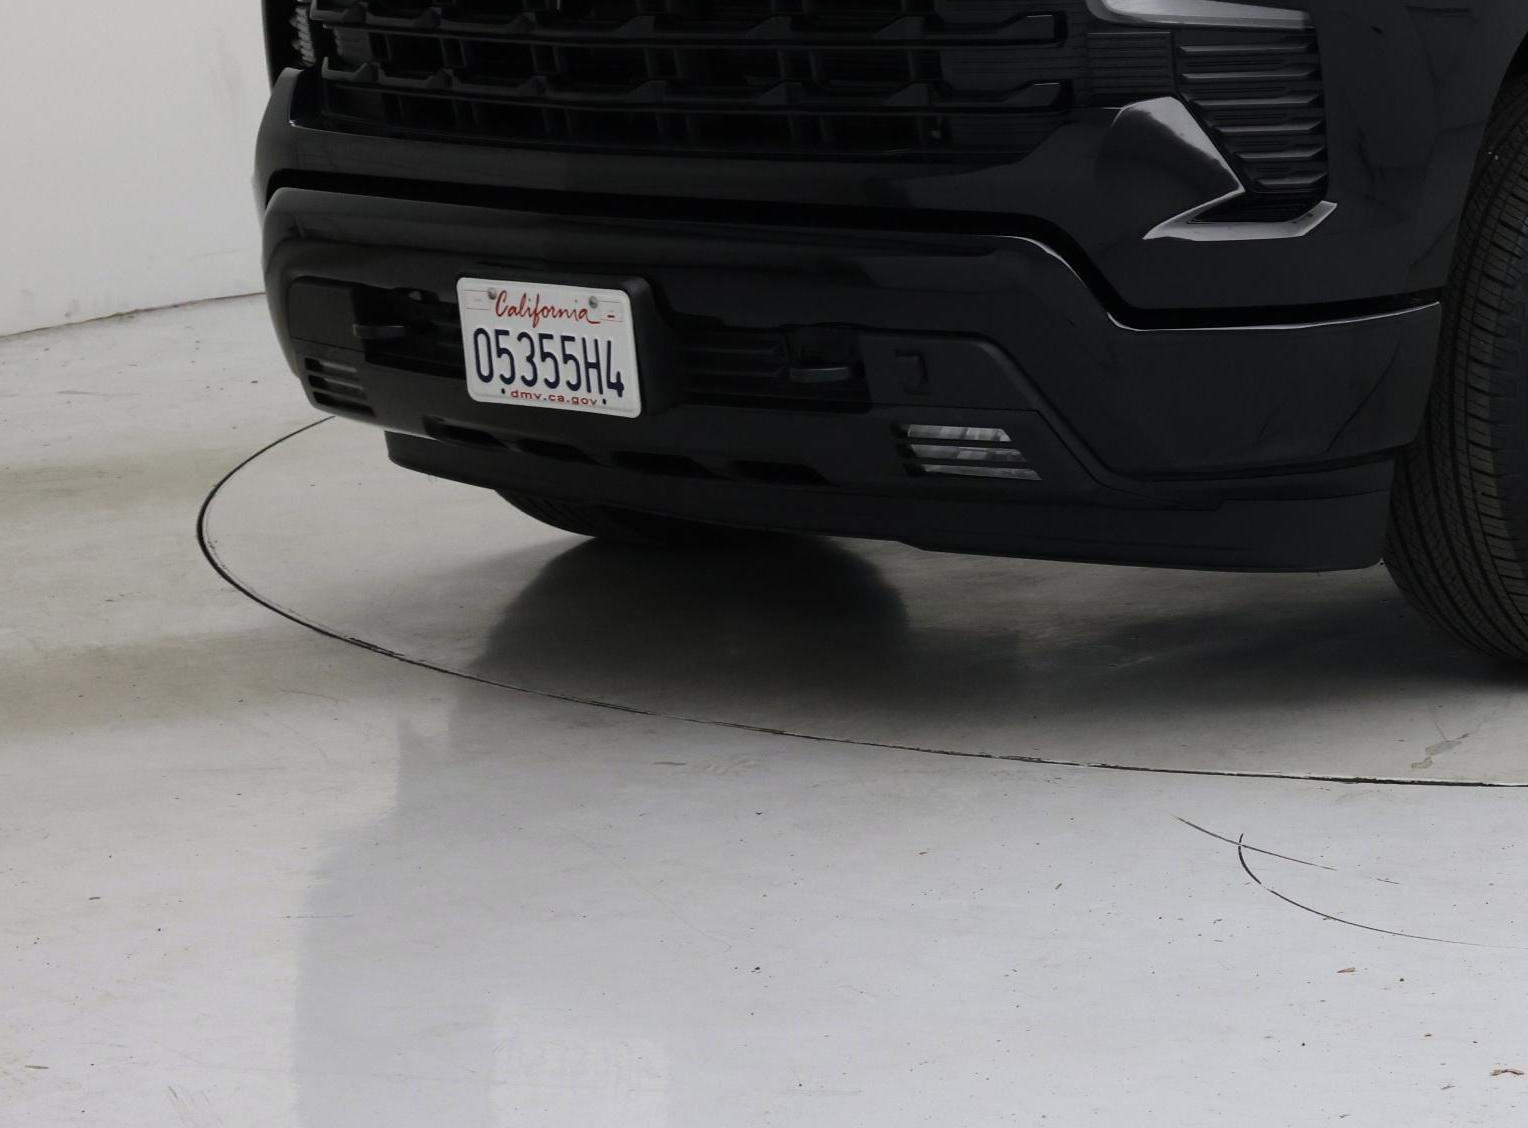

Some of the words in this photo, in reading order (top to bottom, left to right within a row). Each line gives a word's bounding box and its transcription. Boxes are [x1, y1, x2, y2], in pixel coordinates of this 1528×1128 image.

[495, 290, 601, 328] California
[473, 327, 625, 397] 05355H4
[510, 388, 598, 406] dmv.ca.gov
